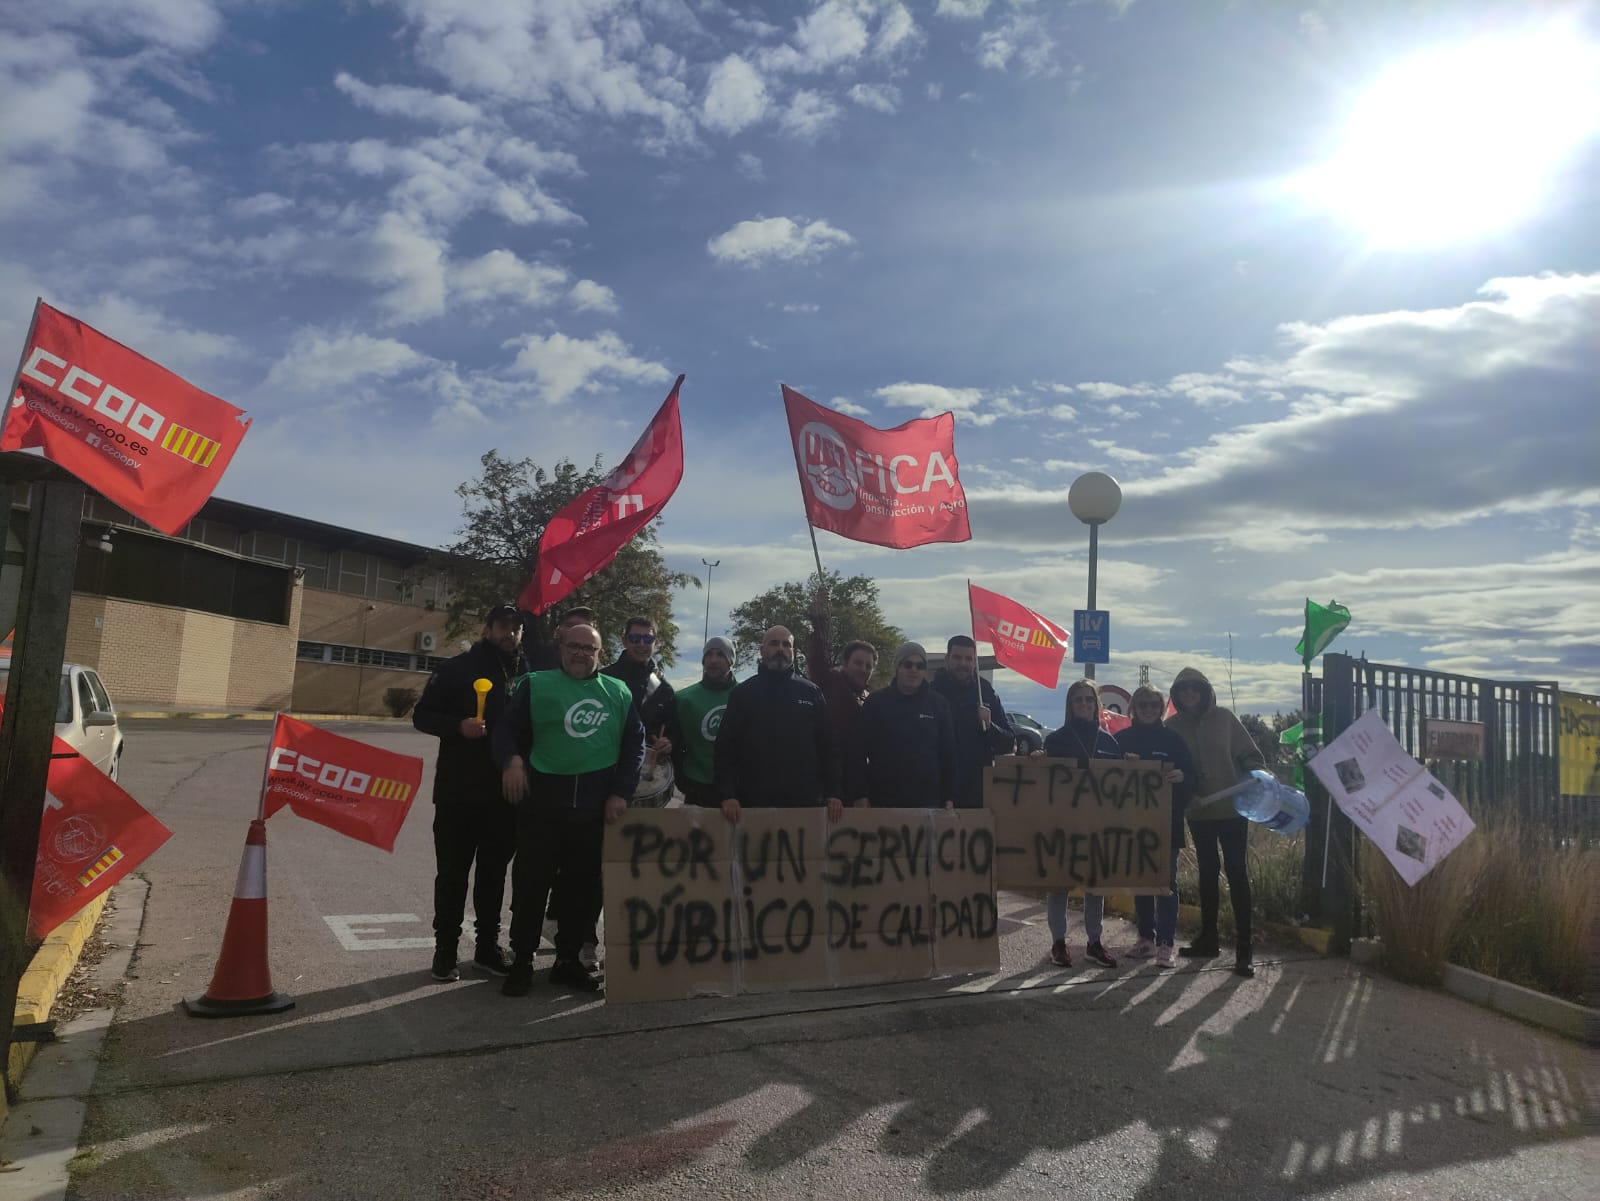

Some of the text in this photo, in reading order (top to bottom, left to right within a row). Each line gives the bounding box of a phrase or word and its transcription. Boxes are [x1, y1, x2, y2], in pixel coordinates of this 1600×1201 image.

[22, 346, 166, 443] CCOO
[855, 450, 955, 495] FICA
[572, 709, 610, 727] CSIF
[269, 746, 372, 795] CCOO
[1048, 763, 1163, 811] PAGAR
[621, 822, 994, 889] POR UN SERVICIO
[1033, 825, 1160, 888] MENTIR
[624, 884, 998, 972] PÚBLICO DE CALIDAD
